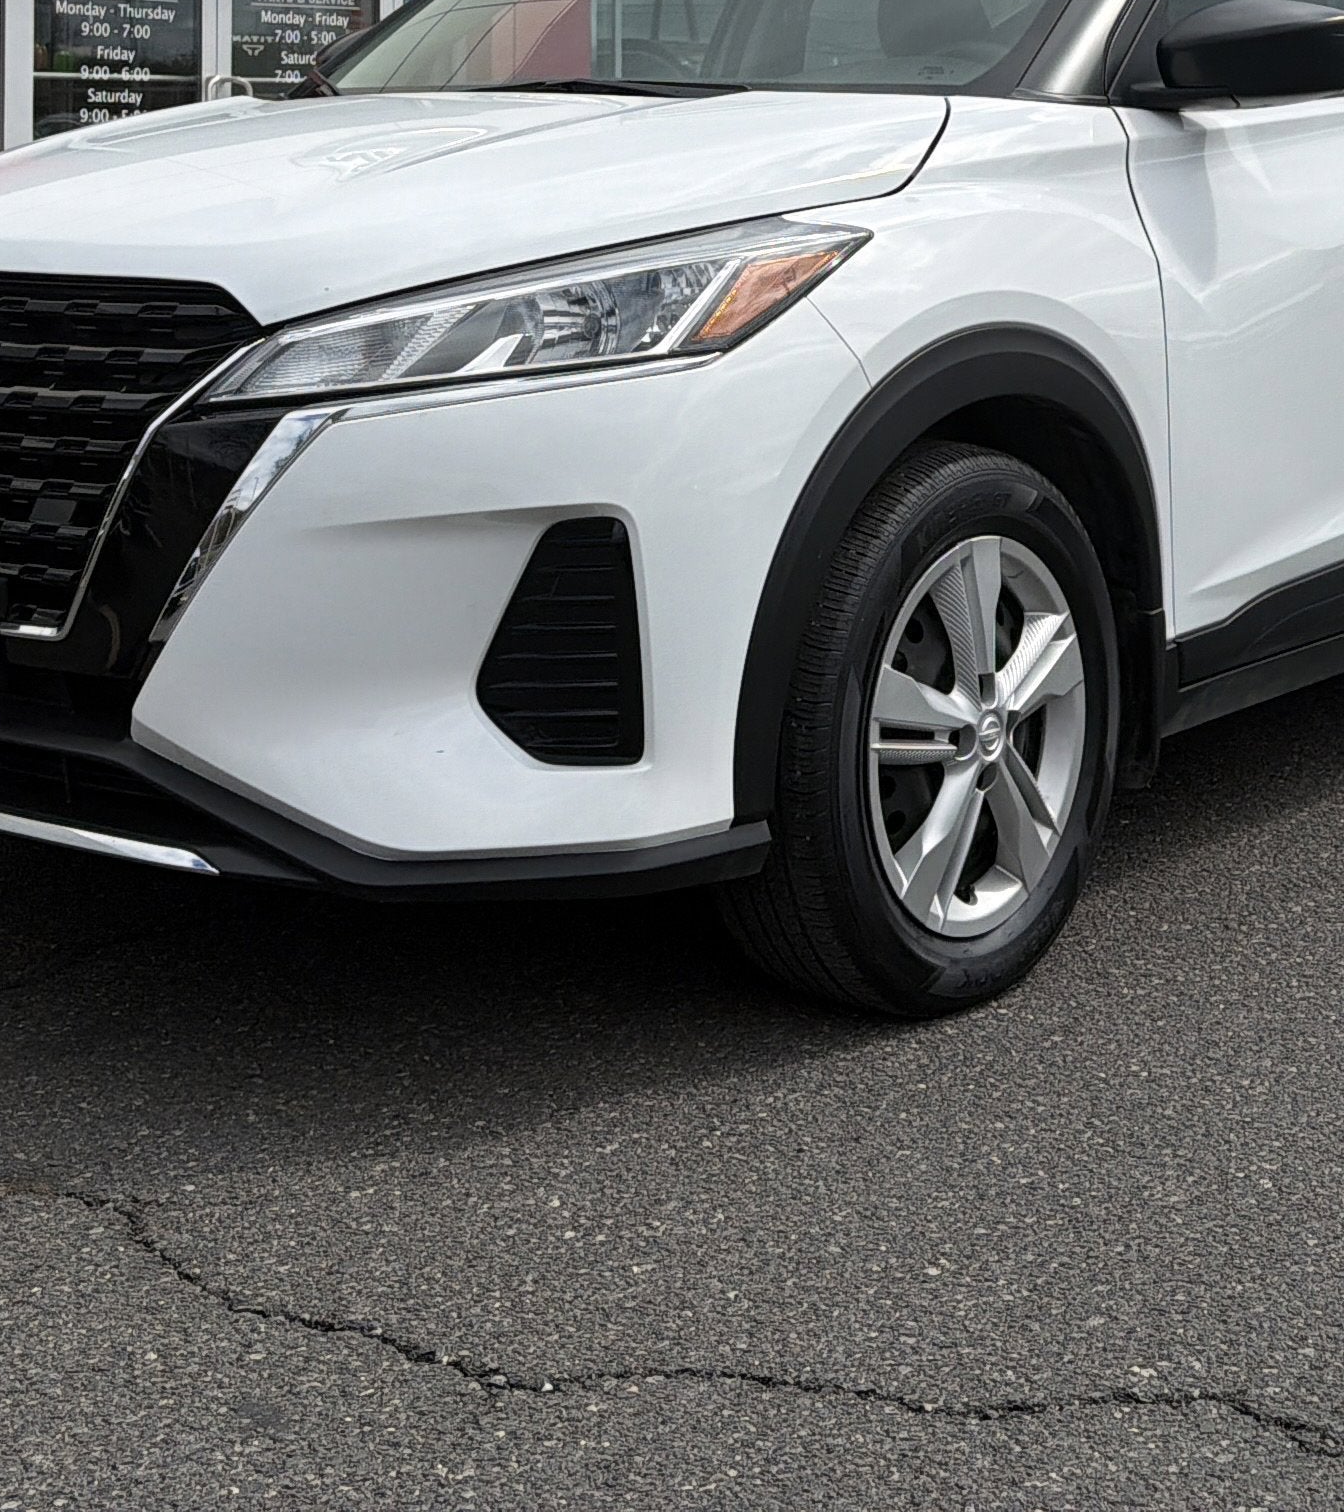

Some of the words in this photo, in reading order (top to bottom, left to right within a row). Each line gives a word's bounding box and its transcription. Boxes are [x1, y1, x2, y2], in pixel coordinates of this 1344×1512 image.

[56, 0, 107, 20] Monday
[118, 3, 176, 23] Thursday
[261, 9, 306, 28] Monday
[316, 12, 350, 29] Friday
[81, 21, 110, 37] 9:00
[122, 23, 151, 39] 7:00
[274, 29, 301, 44] 7:00
[97, 45, 136, 64] Friday
[281, 50, 317, 65] Saturd
[80, 64, 110, 80] 9:00
[121, 66, 150, 81] 6:00
[274, 69, 301, 84] 7:00
[87, 87, 143, 107] Saturday
[79, 107, 109, 124] 9:00
